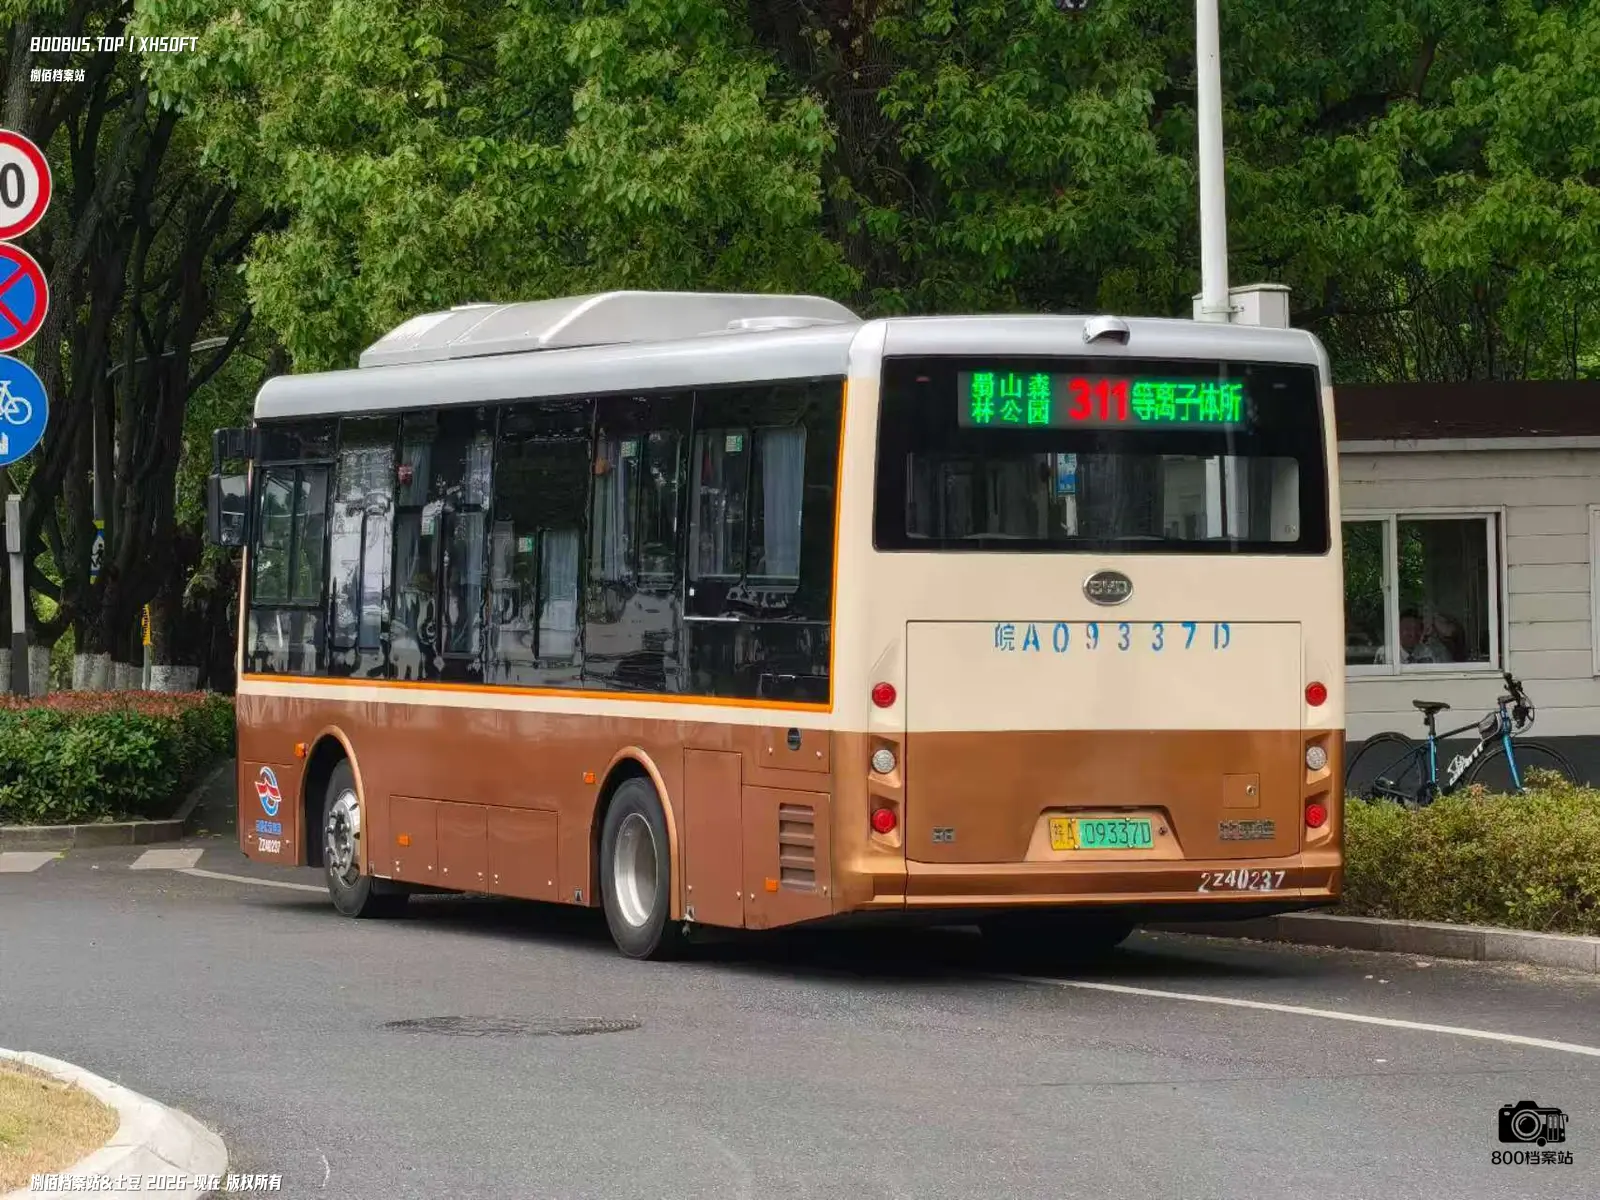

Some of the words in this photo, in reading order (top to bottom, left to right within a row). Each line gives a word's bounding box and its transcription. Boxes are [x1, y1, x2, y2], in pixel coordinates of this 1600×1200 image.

[971, 398, 1050, 424] 林公园
[1068, 378, 1130, 421] 311
[1131, 382, 1243, 422] 等离子体所
